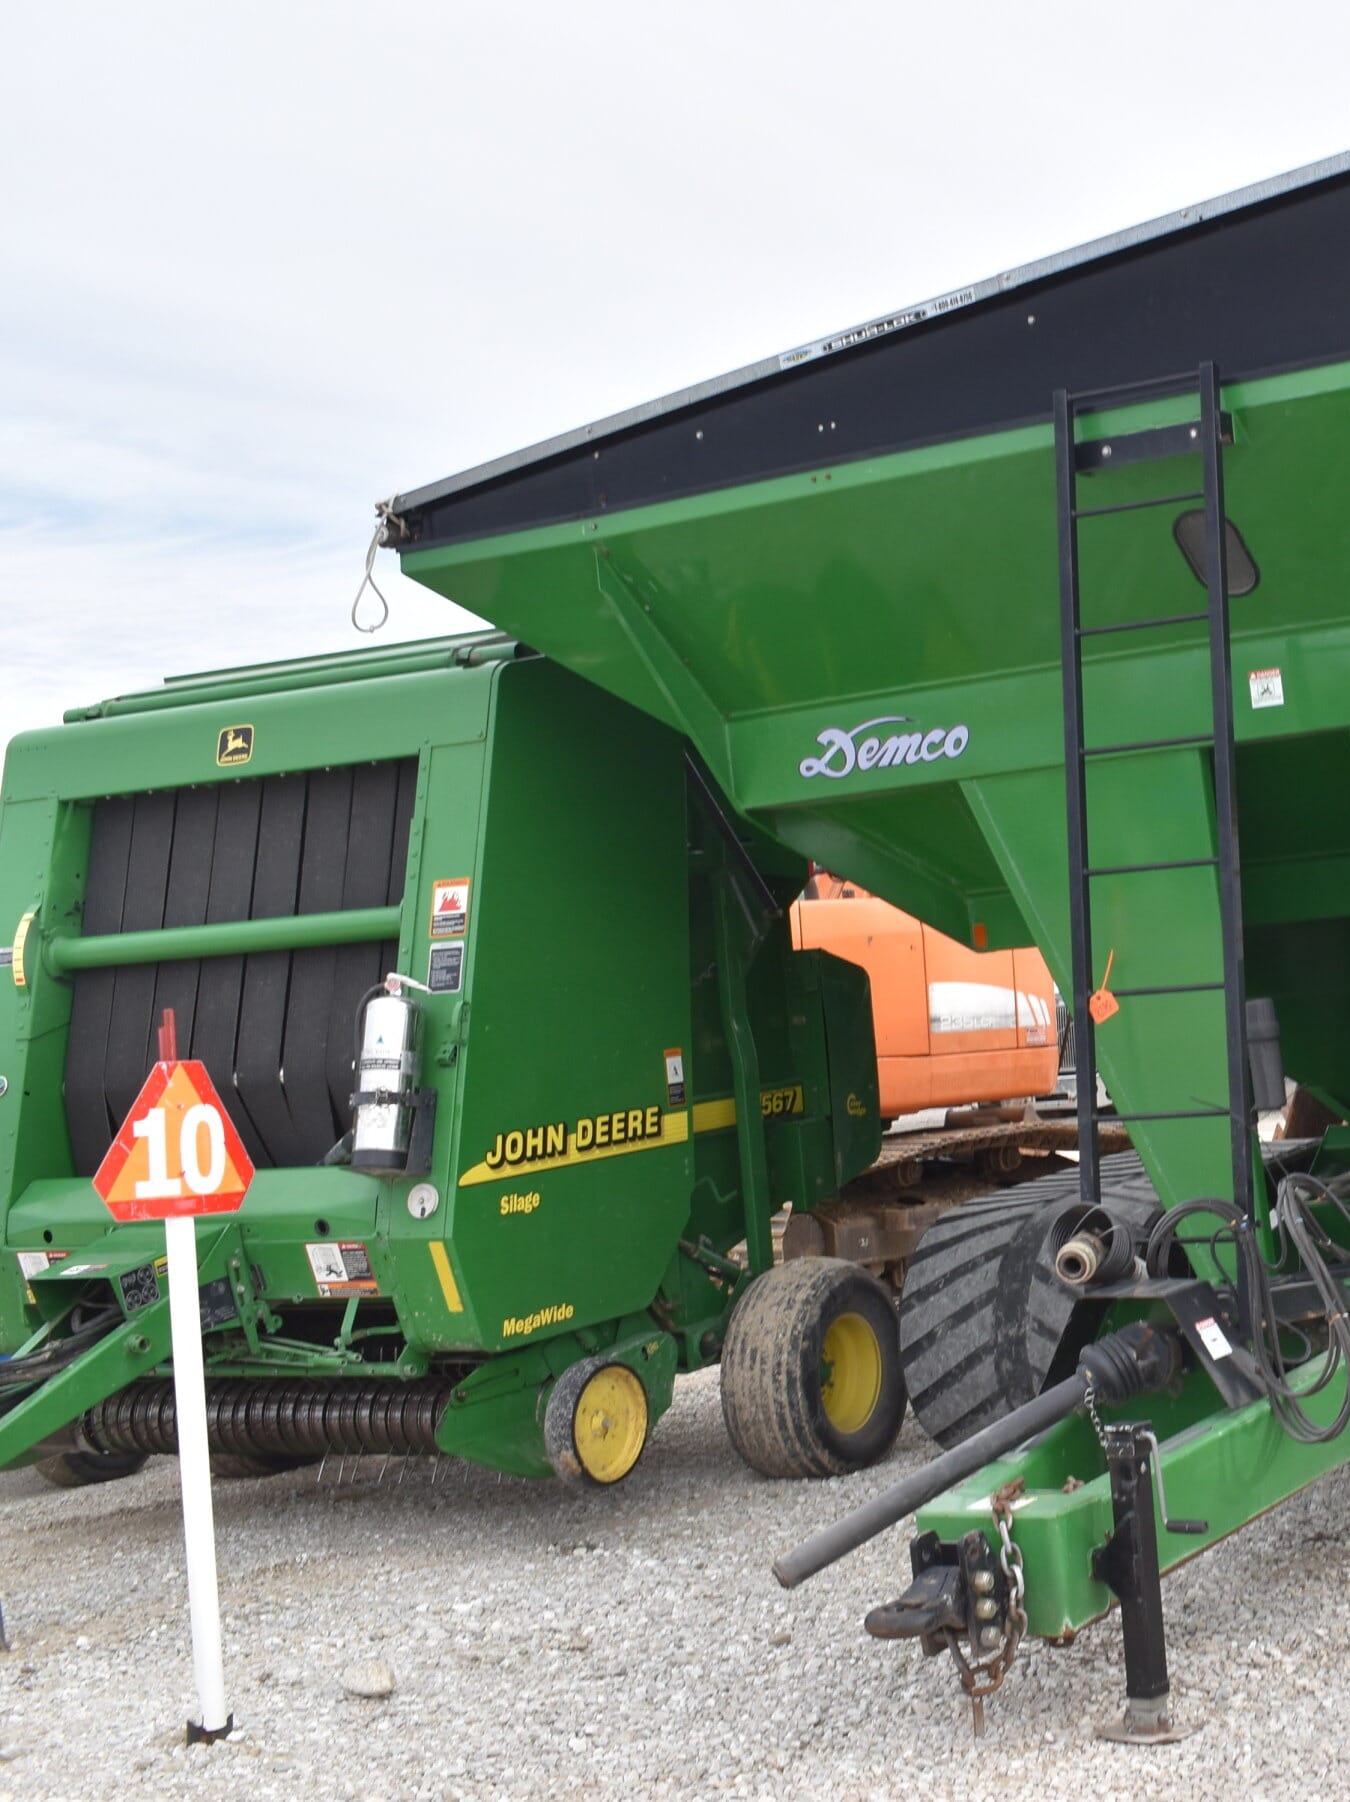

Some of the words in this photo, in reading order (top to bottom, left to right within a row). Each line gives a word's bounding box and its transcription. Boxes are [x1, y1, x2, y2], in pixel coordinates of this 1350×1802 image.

[800, 716, 968, 778] Demco
[761, 1089, 795, 1116] 567
[133, 1103, 227, 1199] 10
[486, 1122, 567, 1167] JOHN
[575, 1106, 661, 1150] DEERE
[500, 1191, 541, 1216] Silage
[503, 1302, 574, 1337] MegaWide
